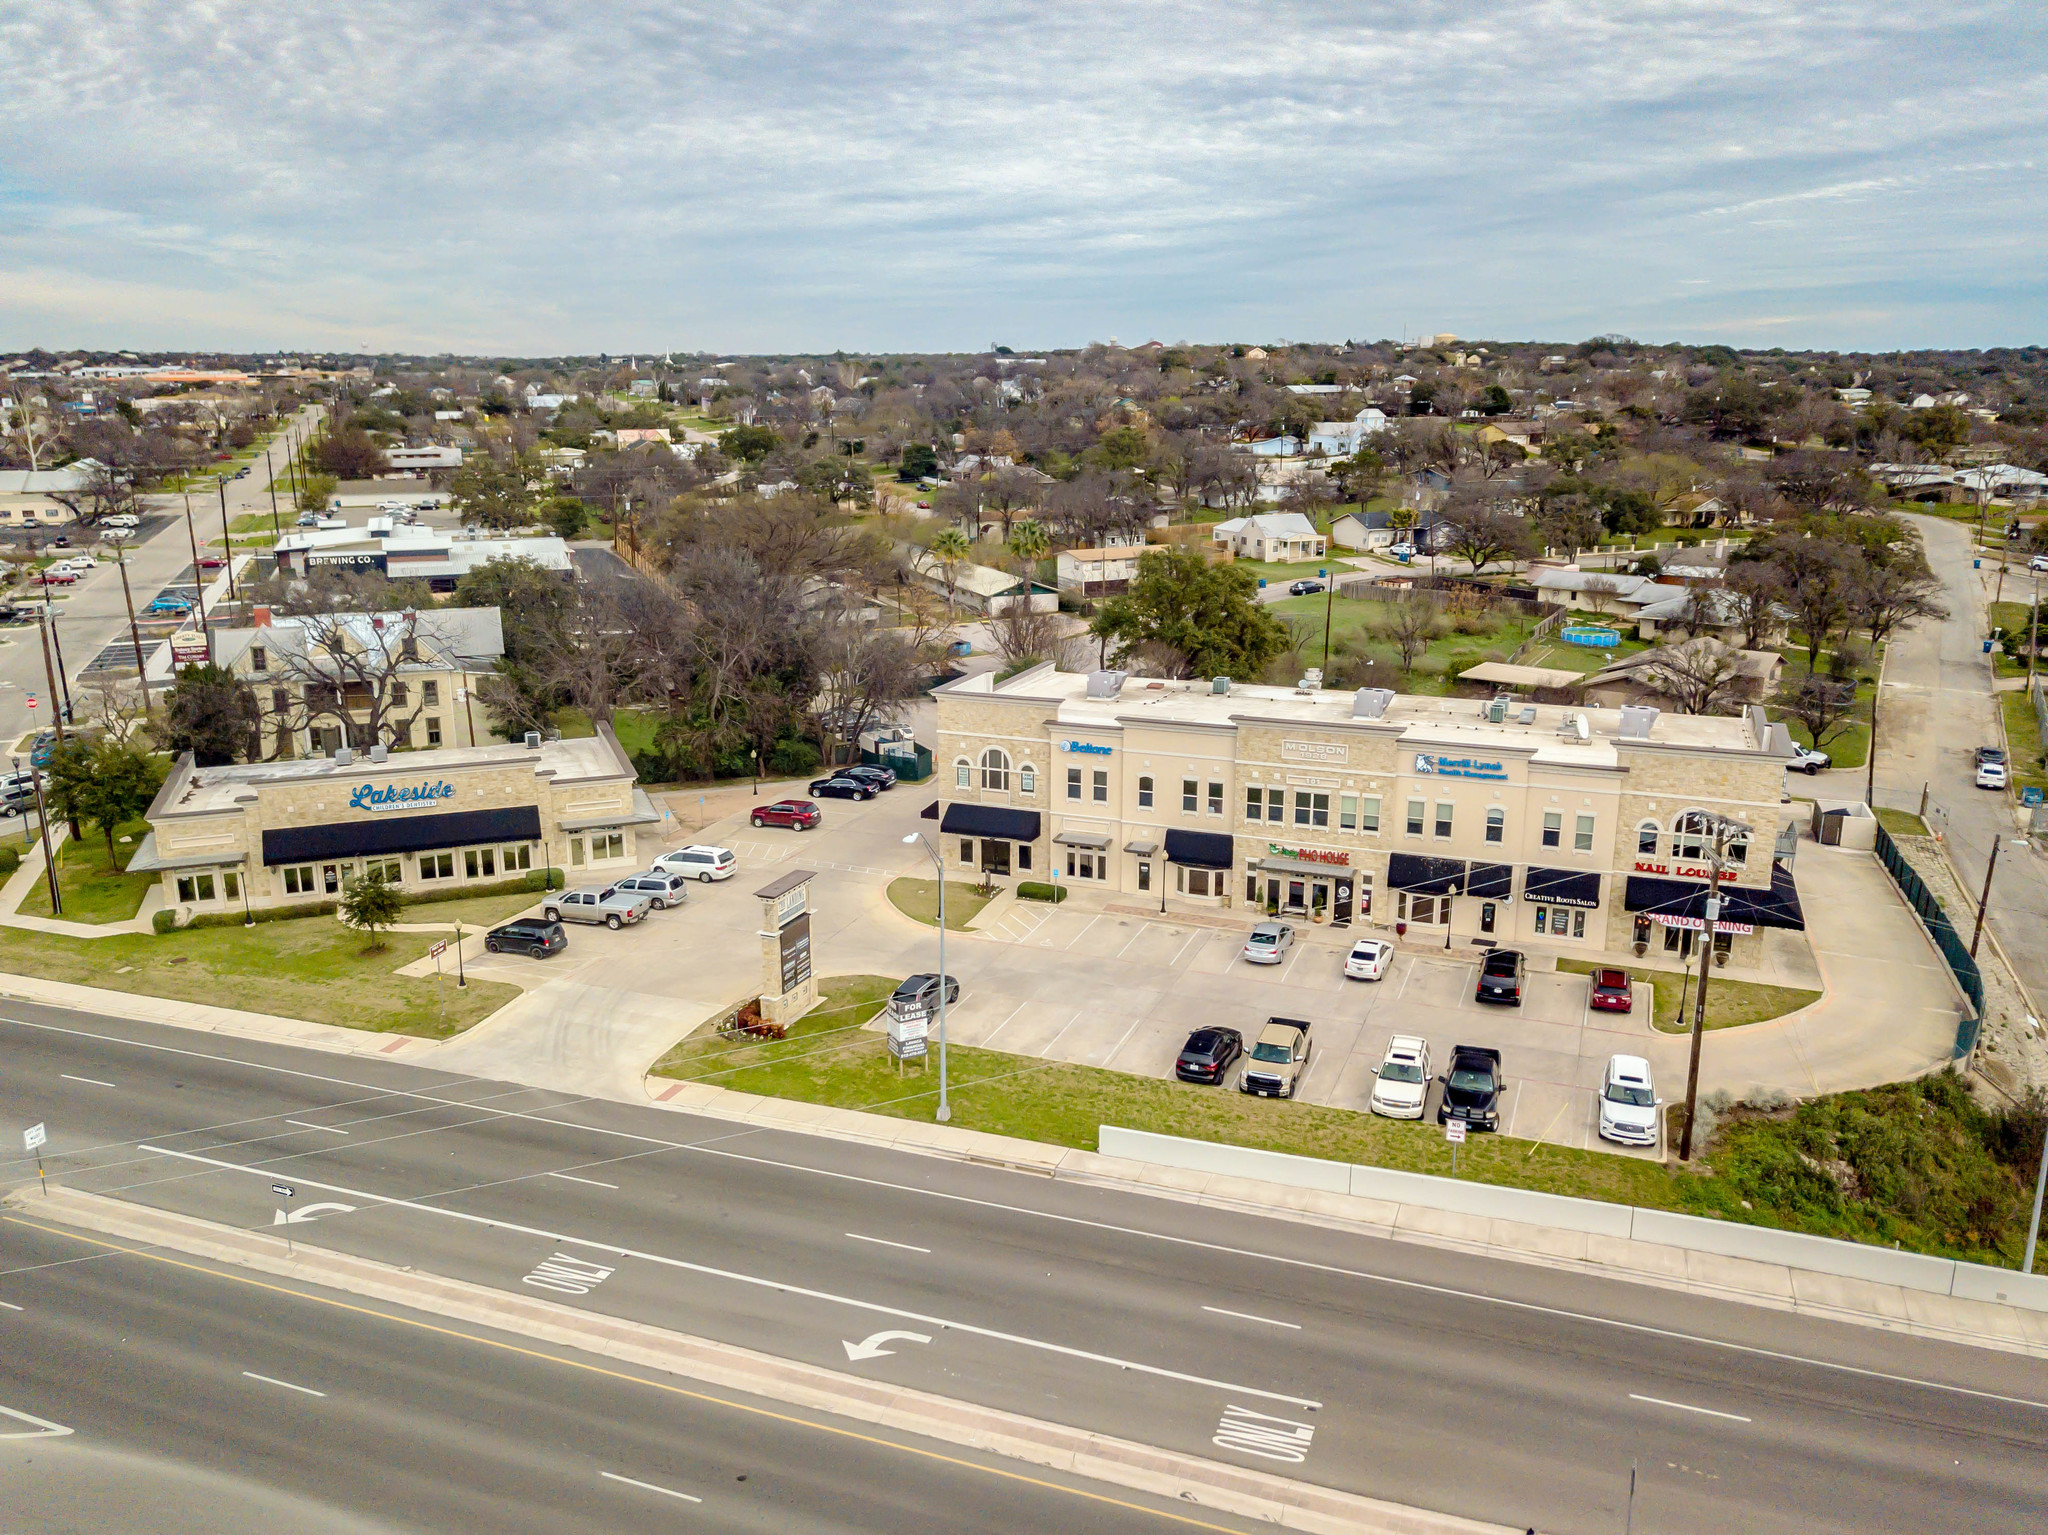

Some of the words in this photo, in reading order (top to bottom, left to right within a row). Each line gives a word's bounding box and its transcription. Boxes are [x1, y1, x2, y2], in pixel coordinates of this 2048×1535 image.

[309, 557, 355, 566] BREWING
[357, 556, 375, 564] CO.
[1070, 741, 1112, 755] Beltone
[1438, 757, 1471, 768] Merrill
[1473, 760, 1502, 770] Lynch
[1463, 770, 1508, 780] Management
[349, 780, 456, 811] Lakeside
[1299, 849, 1319, 862] PHO
[1320, 851, 1350, 865] HOUSE
[1634, 862, 1669, 875] NAIL
[1676, 866, 1738, 881] LOUGE
[1525, 892, 1555, 902] CREATIVE
[1556, 896, 1576, 904] ROOTS
[1577, 898, 1597, 907] SALON
[904, 1002, 922, 1011] FOR
[900, 1010, 927, 1021] LEASE
[522, 1252, 616, 1295] ONLY
[1212, 1404, 1316, 1463] ONLY
